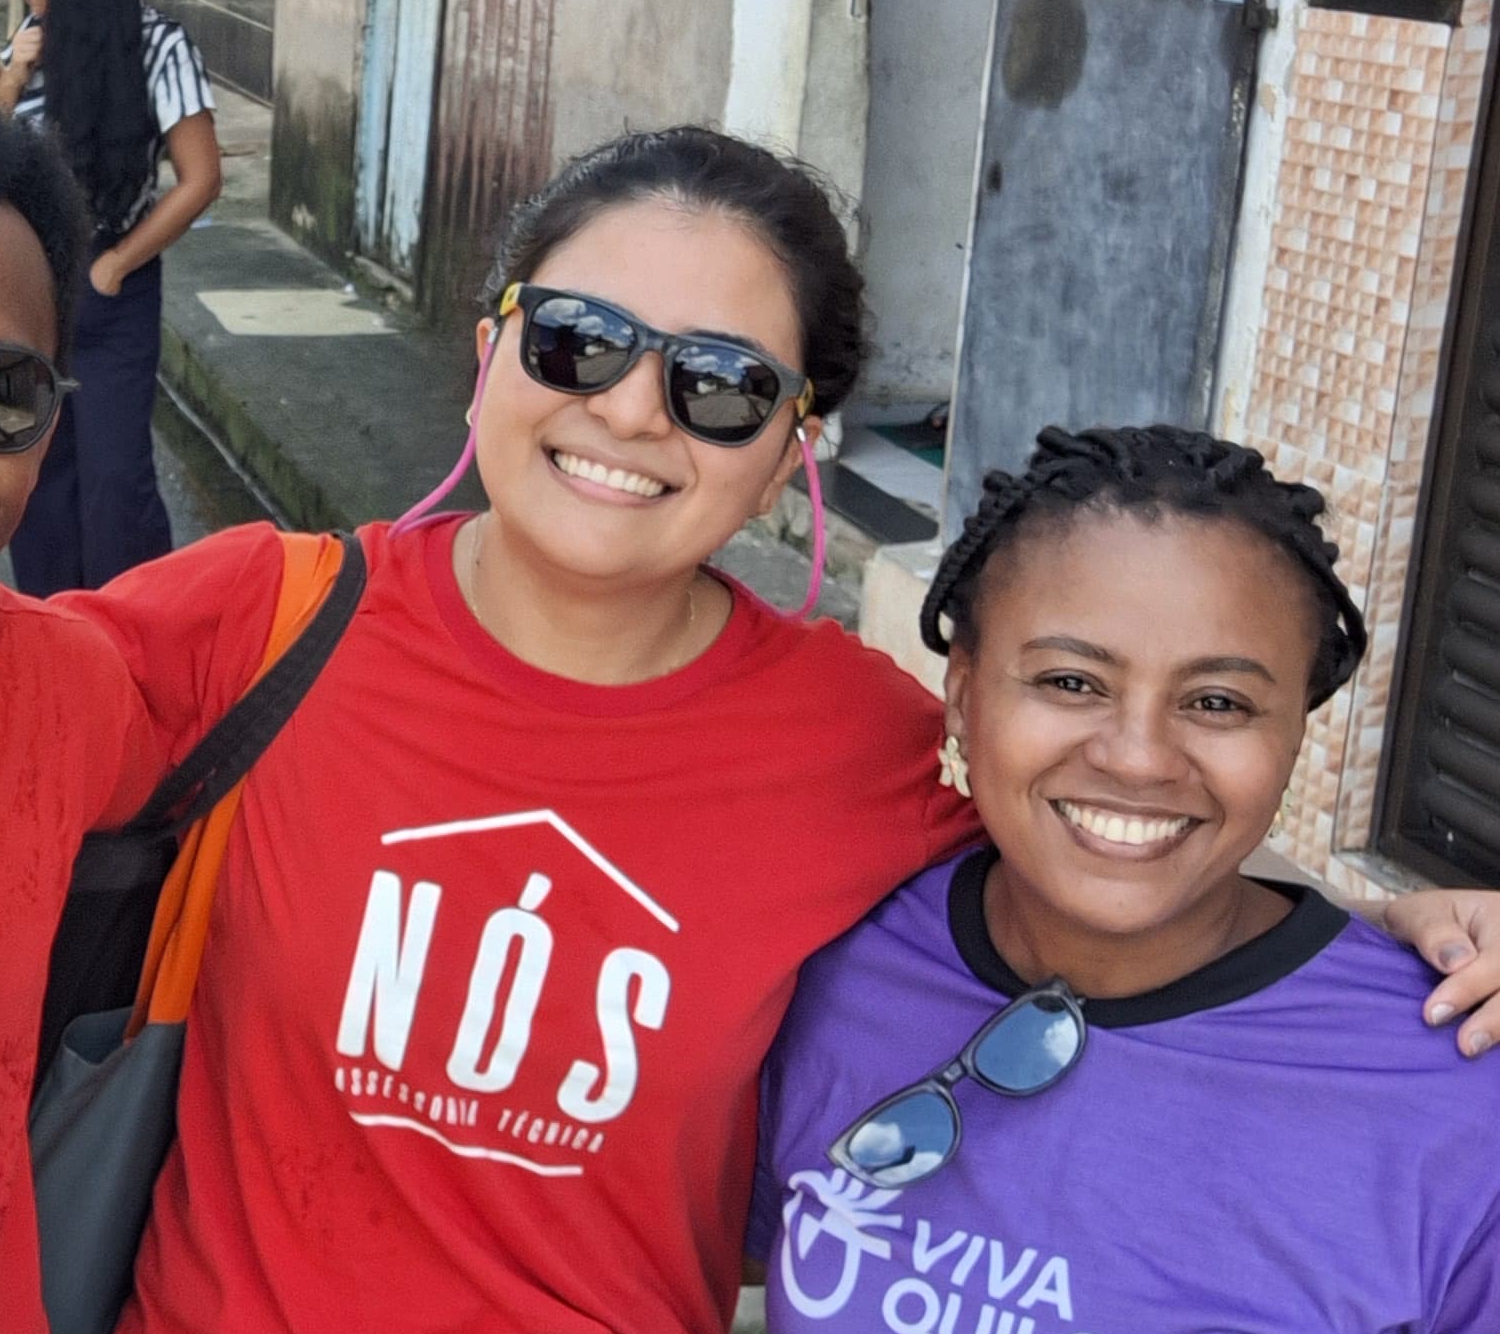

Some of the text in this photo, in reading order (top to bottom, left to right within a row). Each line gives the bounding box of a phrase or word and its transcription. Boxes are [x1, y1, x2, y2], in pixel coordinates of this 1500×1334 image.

[335, 869, 671, 1124] NÓS
[334, 1067, 605, 1154] ASSESSORIA TÉCNICA
[911, 1218, 1074, 1322] VIVA
